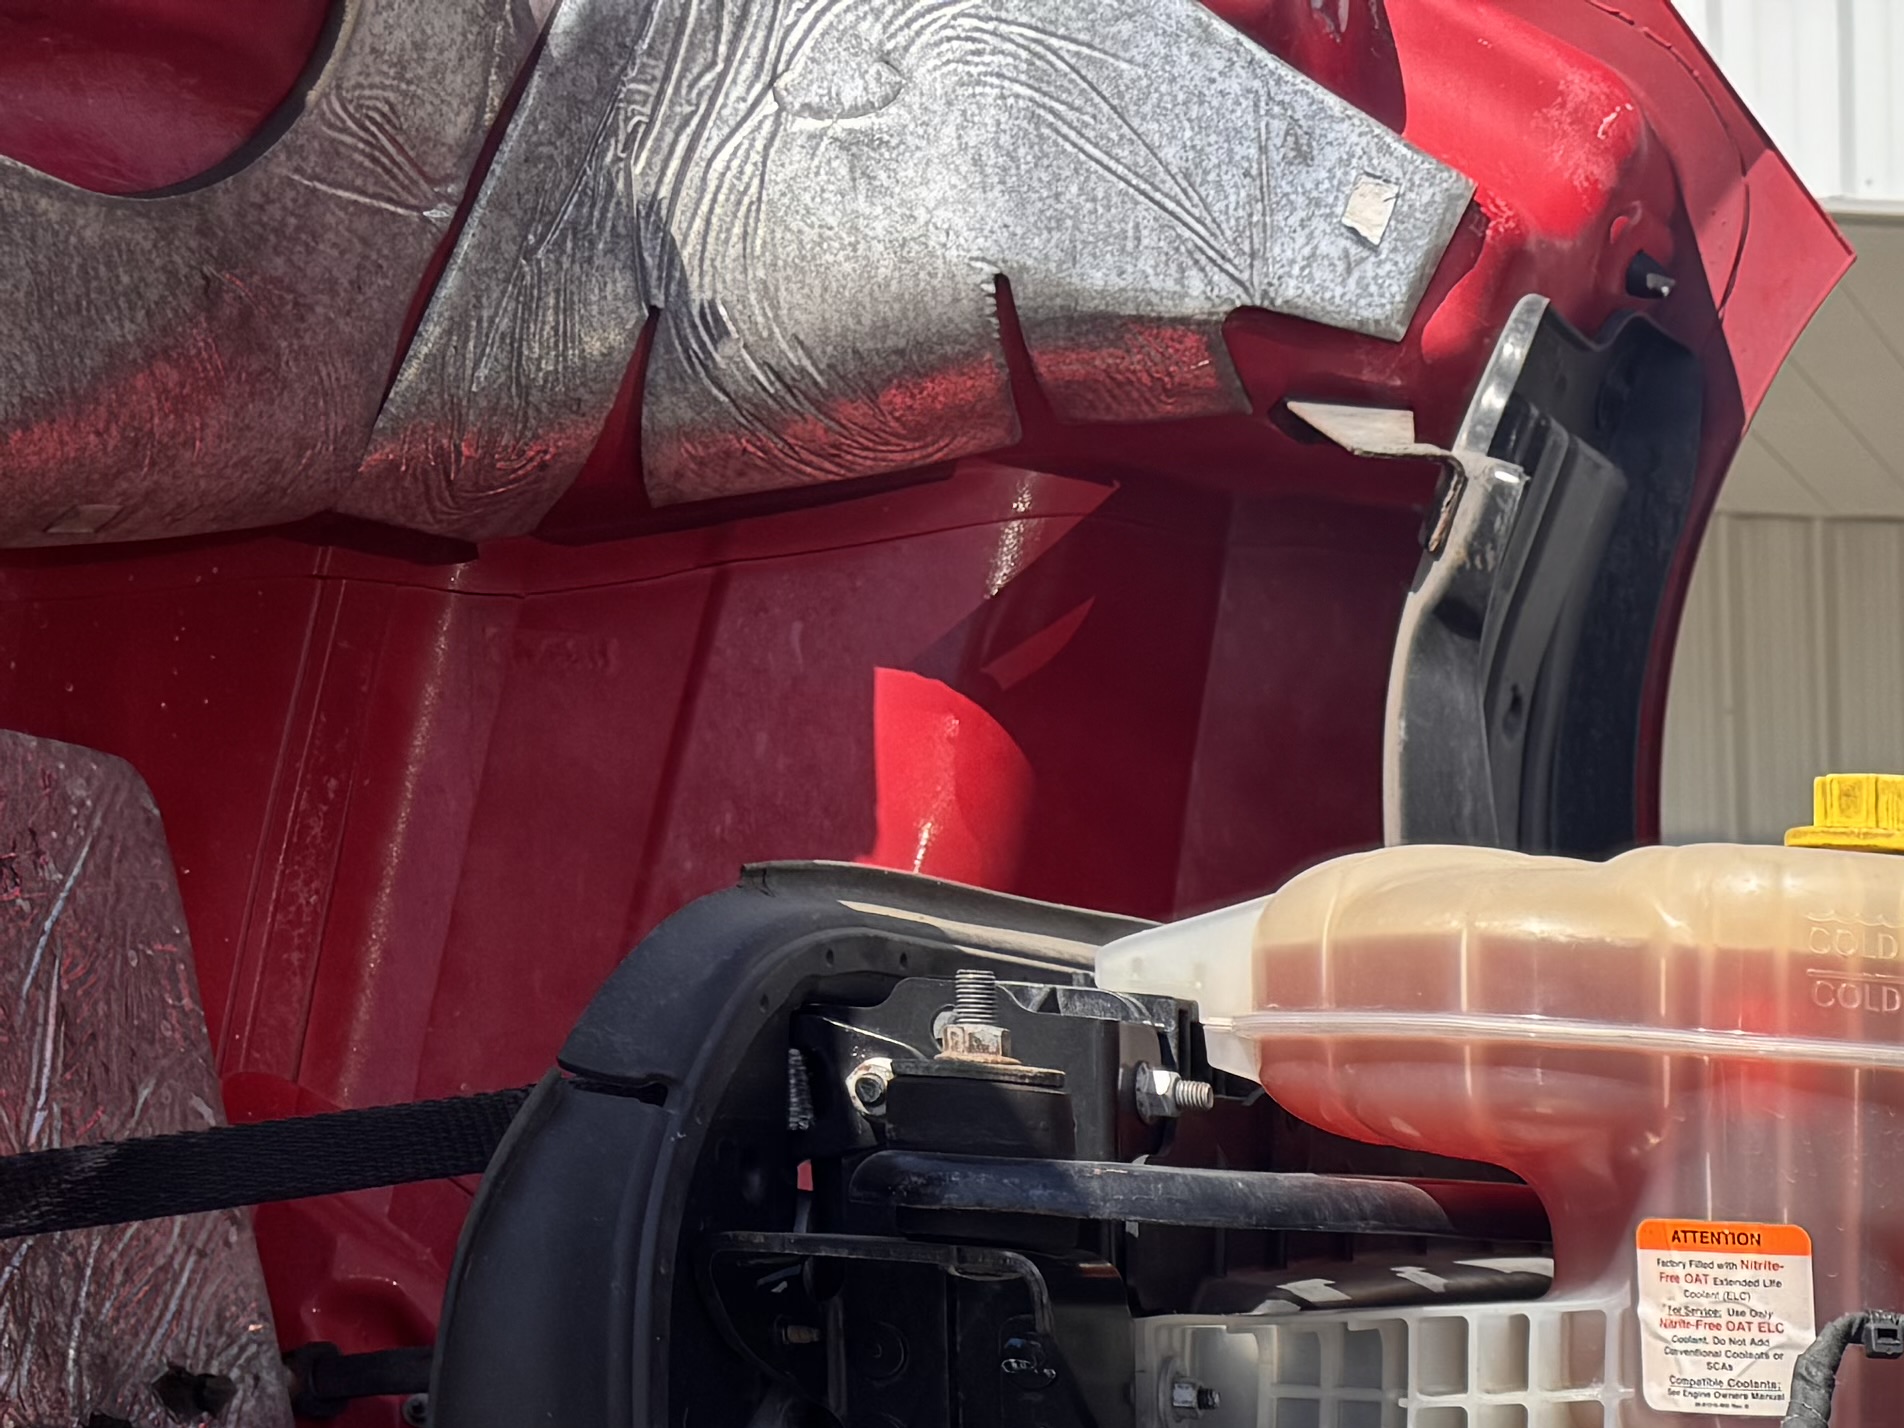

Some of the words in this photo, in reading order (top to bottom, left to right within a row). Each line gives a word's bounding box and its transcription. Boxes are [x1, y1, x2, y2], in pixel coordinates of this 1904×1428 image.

[1808, 927, 1898, 960] COLD
[1812, 980, 1901, 1013] COLD
[1672, 1230, 1761, 1246] ATTENTION
[1657, 1258, 1686, 1270] Factory
[1689, 1260, 1715, 1270] Filled
[1717, 1261, 1738, 1271] with
[1740, 1260, 1784, 1272] Nitrite-
[1659, 1272, 1680, 1284] Free
[1684, 1273, 1709, 1285] OAT
[1713, 1275, 1760, 1288] Extended
[1763, 1278, 1782, 1288] Life
[1683, 1289, 1720, 1301] Coolant
[1723, 1291, 1751, 1302] (ELC)
[1727, 1308, 1746, 1317] Use
[1750, 1309, 1774, 1320] Only
[1659, 1318, 1722, 1331] Nitrite-Free
[1726, 1320, 1752, 1332] OAT
[1758, 1321, 1785, 1334] ELC
[1713, 1336, 1726, 1346] Do
[1729, 1337, 1746, 1346] Not
[1750, 1337, 1770, 1347] Add
[1664, 1347, 1722, 1359] Conventional
[1773, 1352, 1784, 1360] or
[1669, 1375, 1724, 1388] Compatible
[1683, 1389, 1711, 1400] Engine
[1751, 1392, 1785, 1401] Manual
